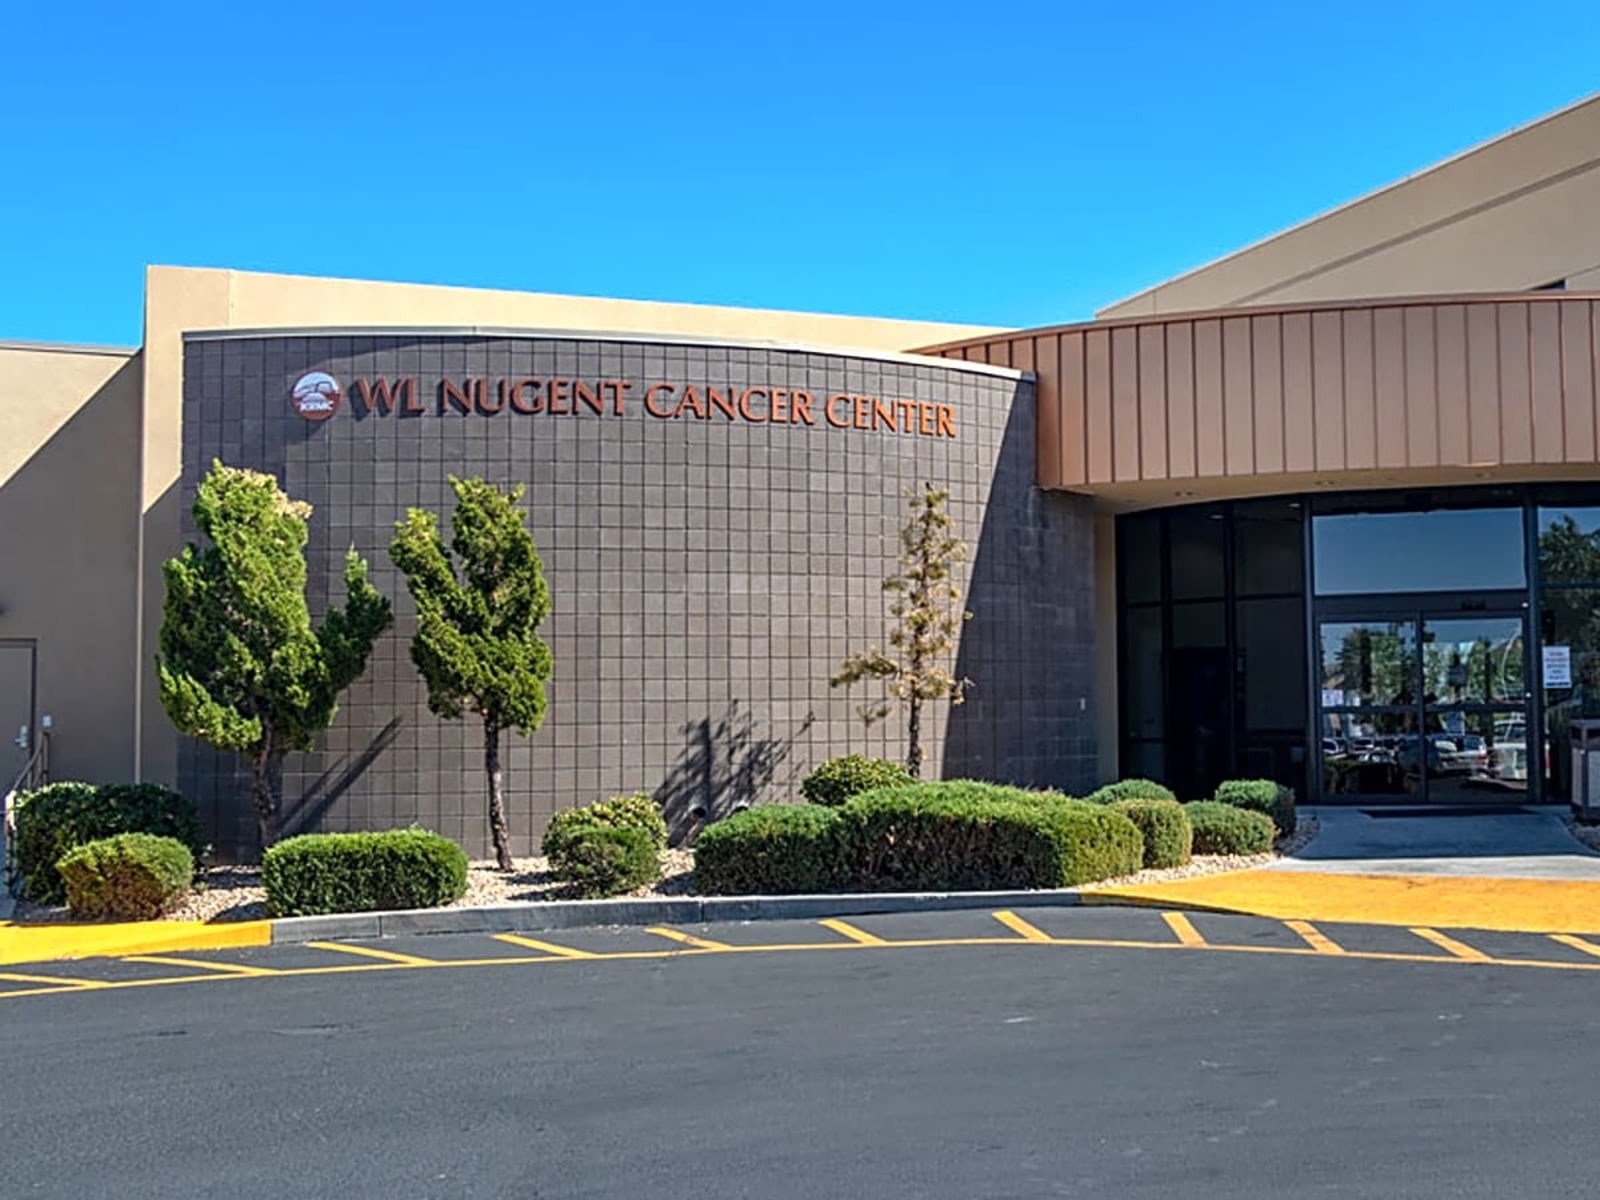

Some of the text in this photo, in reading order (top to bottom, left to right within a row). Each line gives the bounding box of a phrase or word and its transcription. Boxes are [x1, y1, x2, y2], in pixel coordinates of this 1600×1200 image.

[354, 376, 956, 437] WL NUGENT CANCER CENTER
